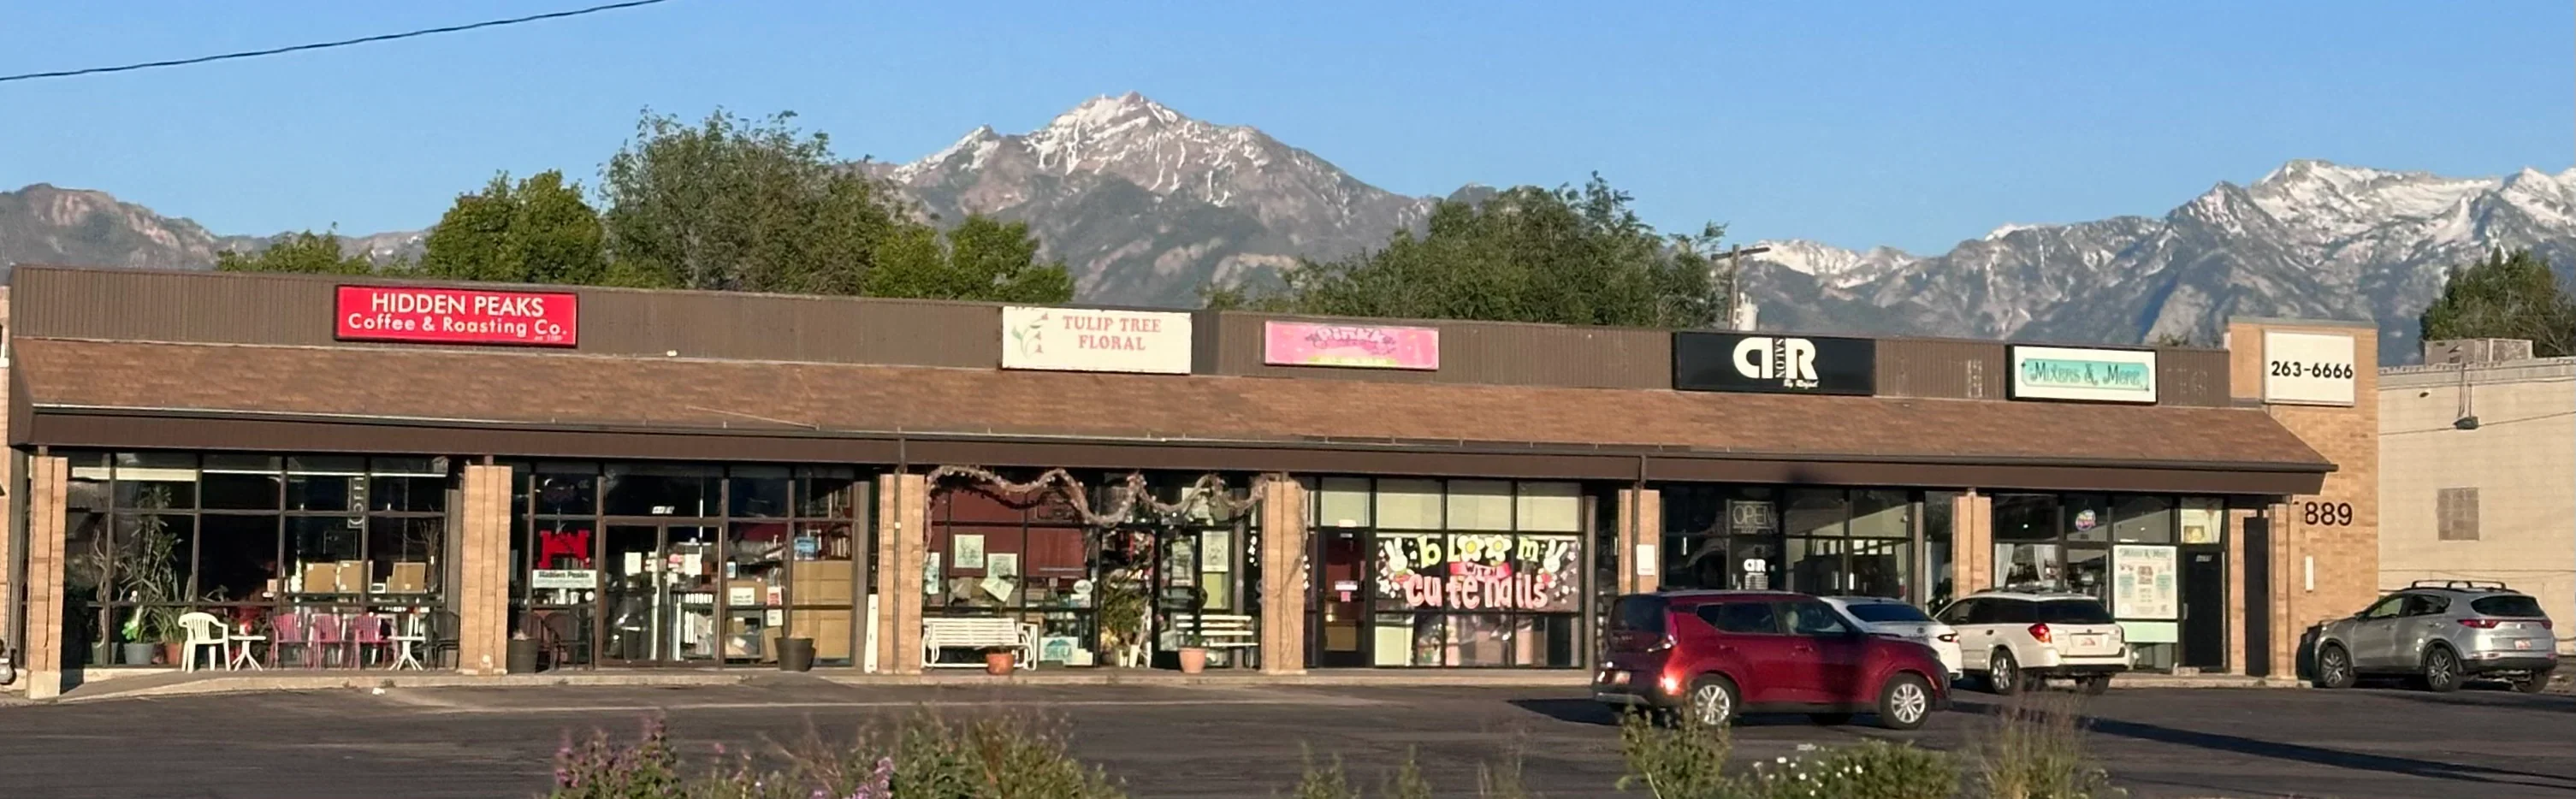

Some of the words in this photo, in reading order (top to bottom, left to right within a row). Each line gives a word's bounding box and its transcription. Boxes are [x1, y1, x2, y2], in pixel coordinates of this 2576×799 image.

[371, 293, 466, 315] HIDDEN
[474, 295, 544, 317] PEAKS
[348, 313, 416, 331] Coffee
[422, 316, 435, 332] &
[442, 317, 527, 338] Roasting
[534, 320, 567, 335] Co.
[1062, 316, 1114, 332] TULIP
[1119, 318, 1163, 333] TREE
[1078, 334, 1146, 351] FLORAL
[1774, 337, 1785, 379] SALON
[2084, 363, 2099, 386] &
[2271, 360, 2354, 380] 263-6666
[1732, 505, 1774, 524] OPEN
[2294, 500, 2353, 526] 889
[1484, 571, 1549, 609] nails
